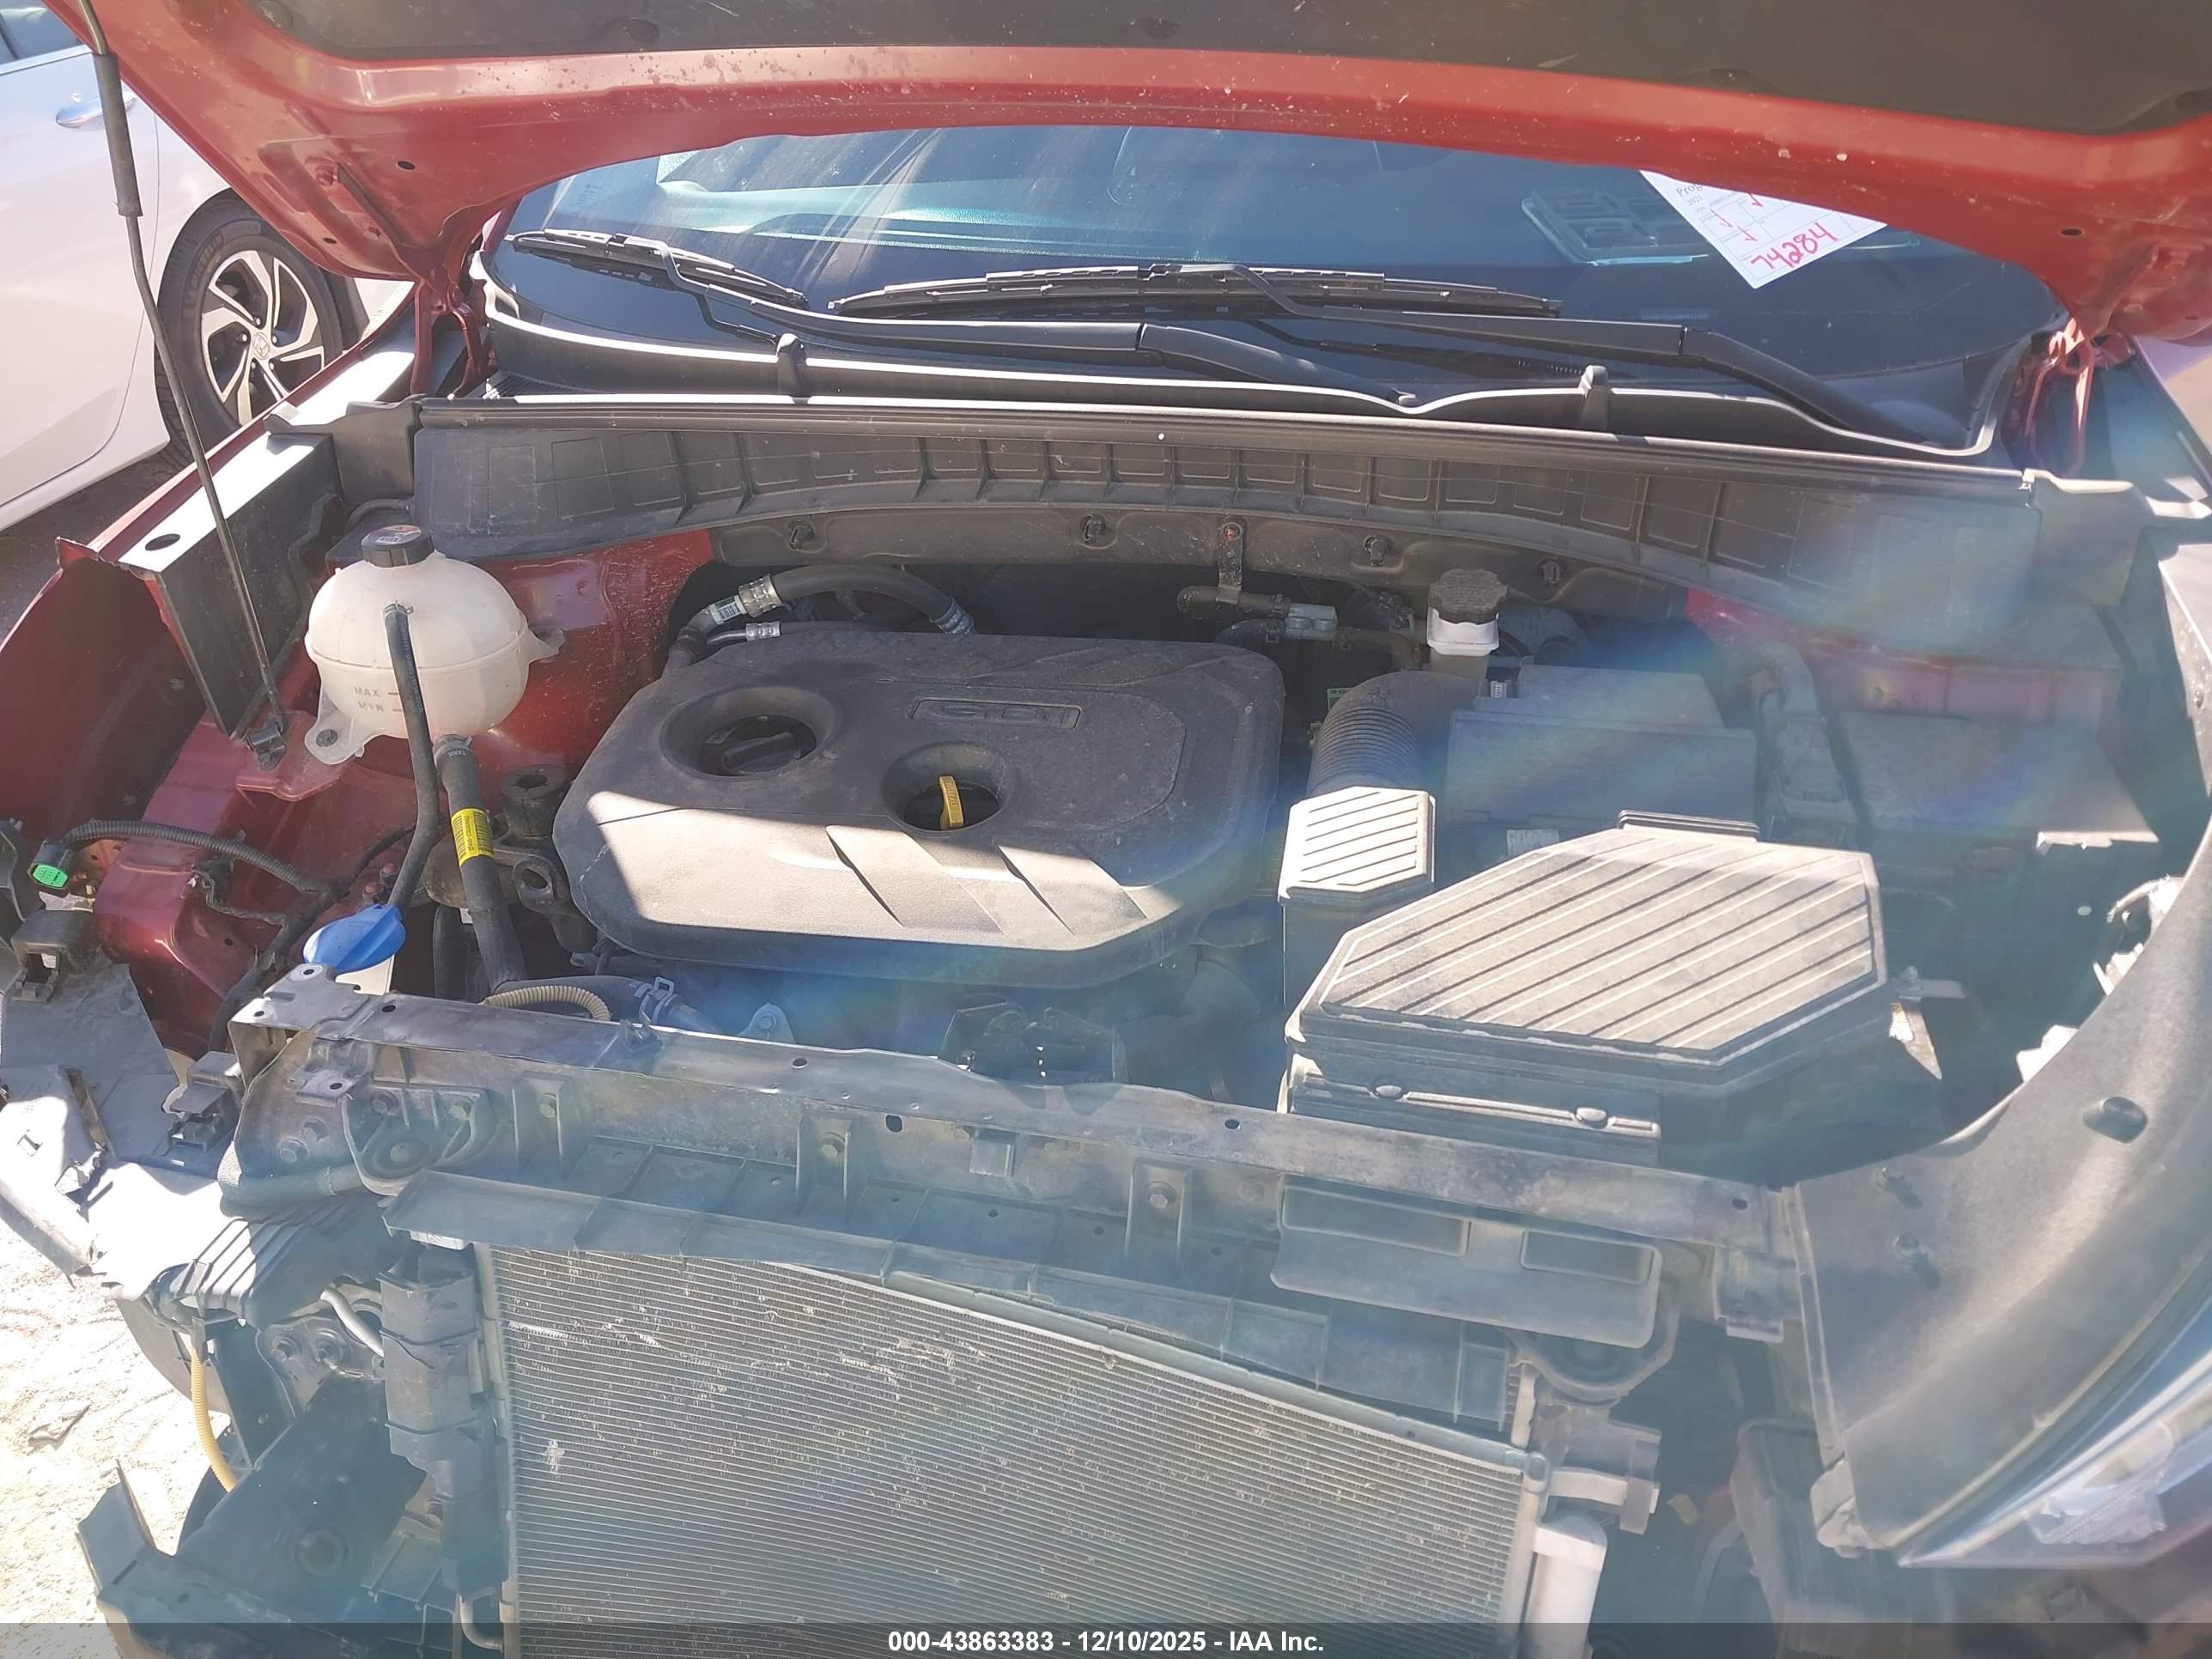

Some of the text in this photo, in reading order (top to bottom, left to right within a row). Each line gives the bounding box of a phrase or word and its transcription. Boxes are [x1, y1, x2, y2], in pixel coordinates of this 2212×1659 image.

[1751, 222, 1838, 269] 74284
[354, 686, 380, 697] MAX
[358, 701, 384, 712] MIN
